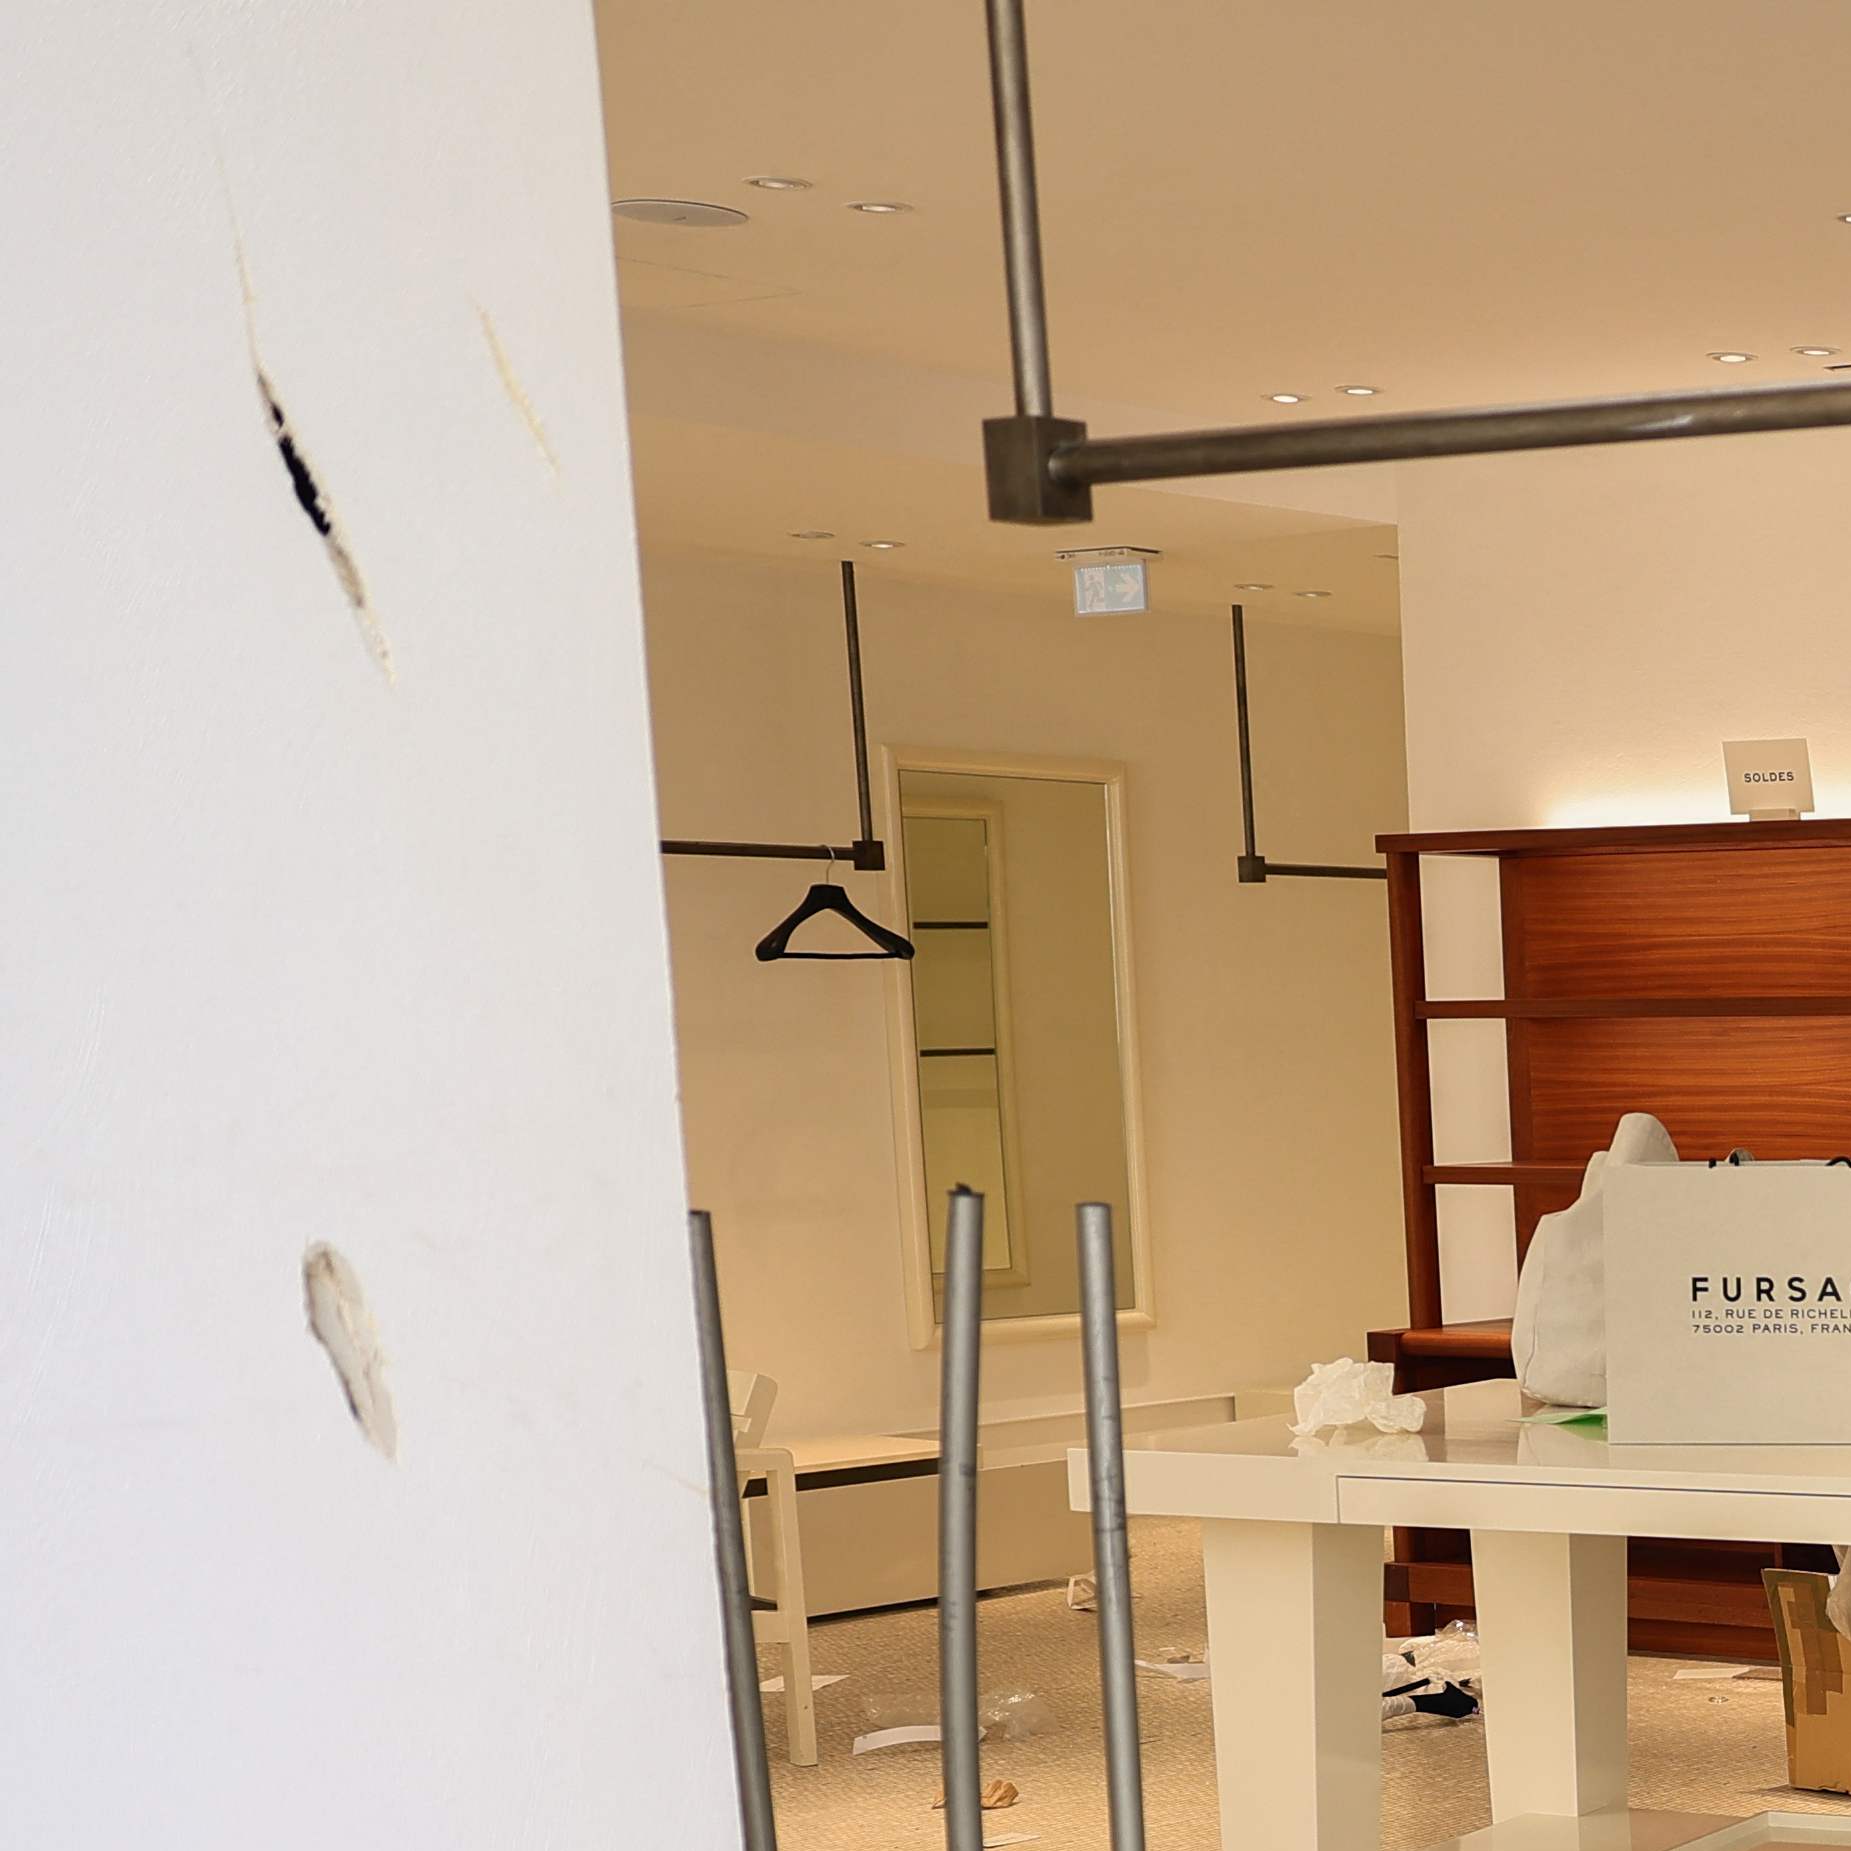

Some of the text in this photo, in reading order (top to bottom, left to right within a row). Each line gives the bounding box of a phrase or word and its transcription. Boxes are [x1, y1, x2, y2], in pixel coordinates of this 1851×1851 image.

[1744, 771, 1794, 783] SOLDES
[1692, 1309, 1719, 1321] 112,
[1725, 1308, 1758, 1320] RUE
[1763, 1308, 1784, 1320] DE
[1692, 1324, 1744, 1335] 75002
[1752, 1323, 1804, 1336] PARIS,
